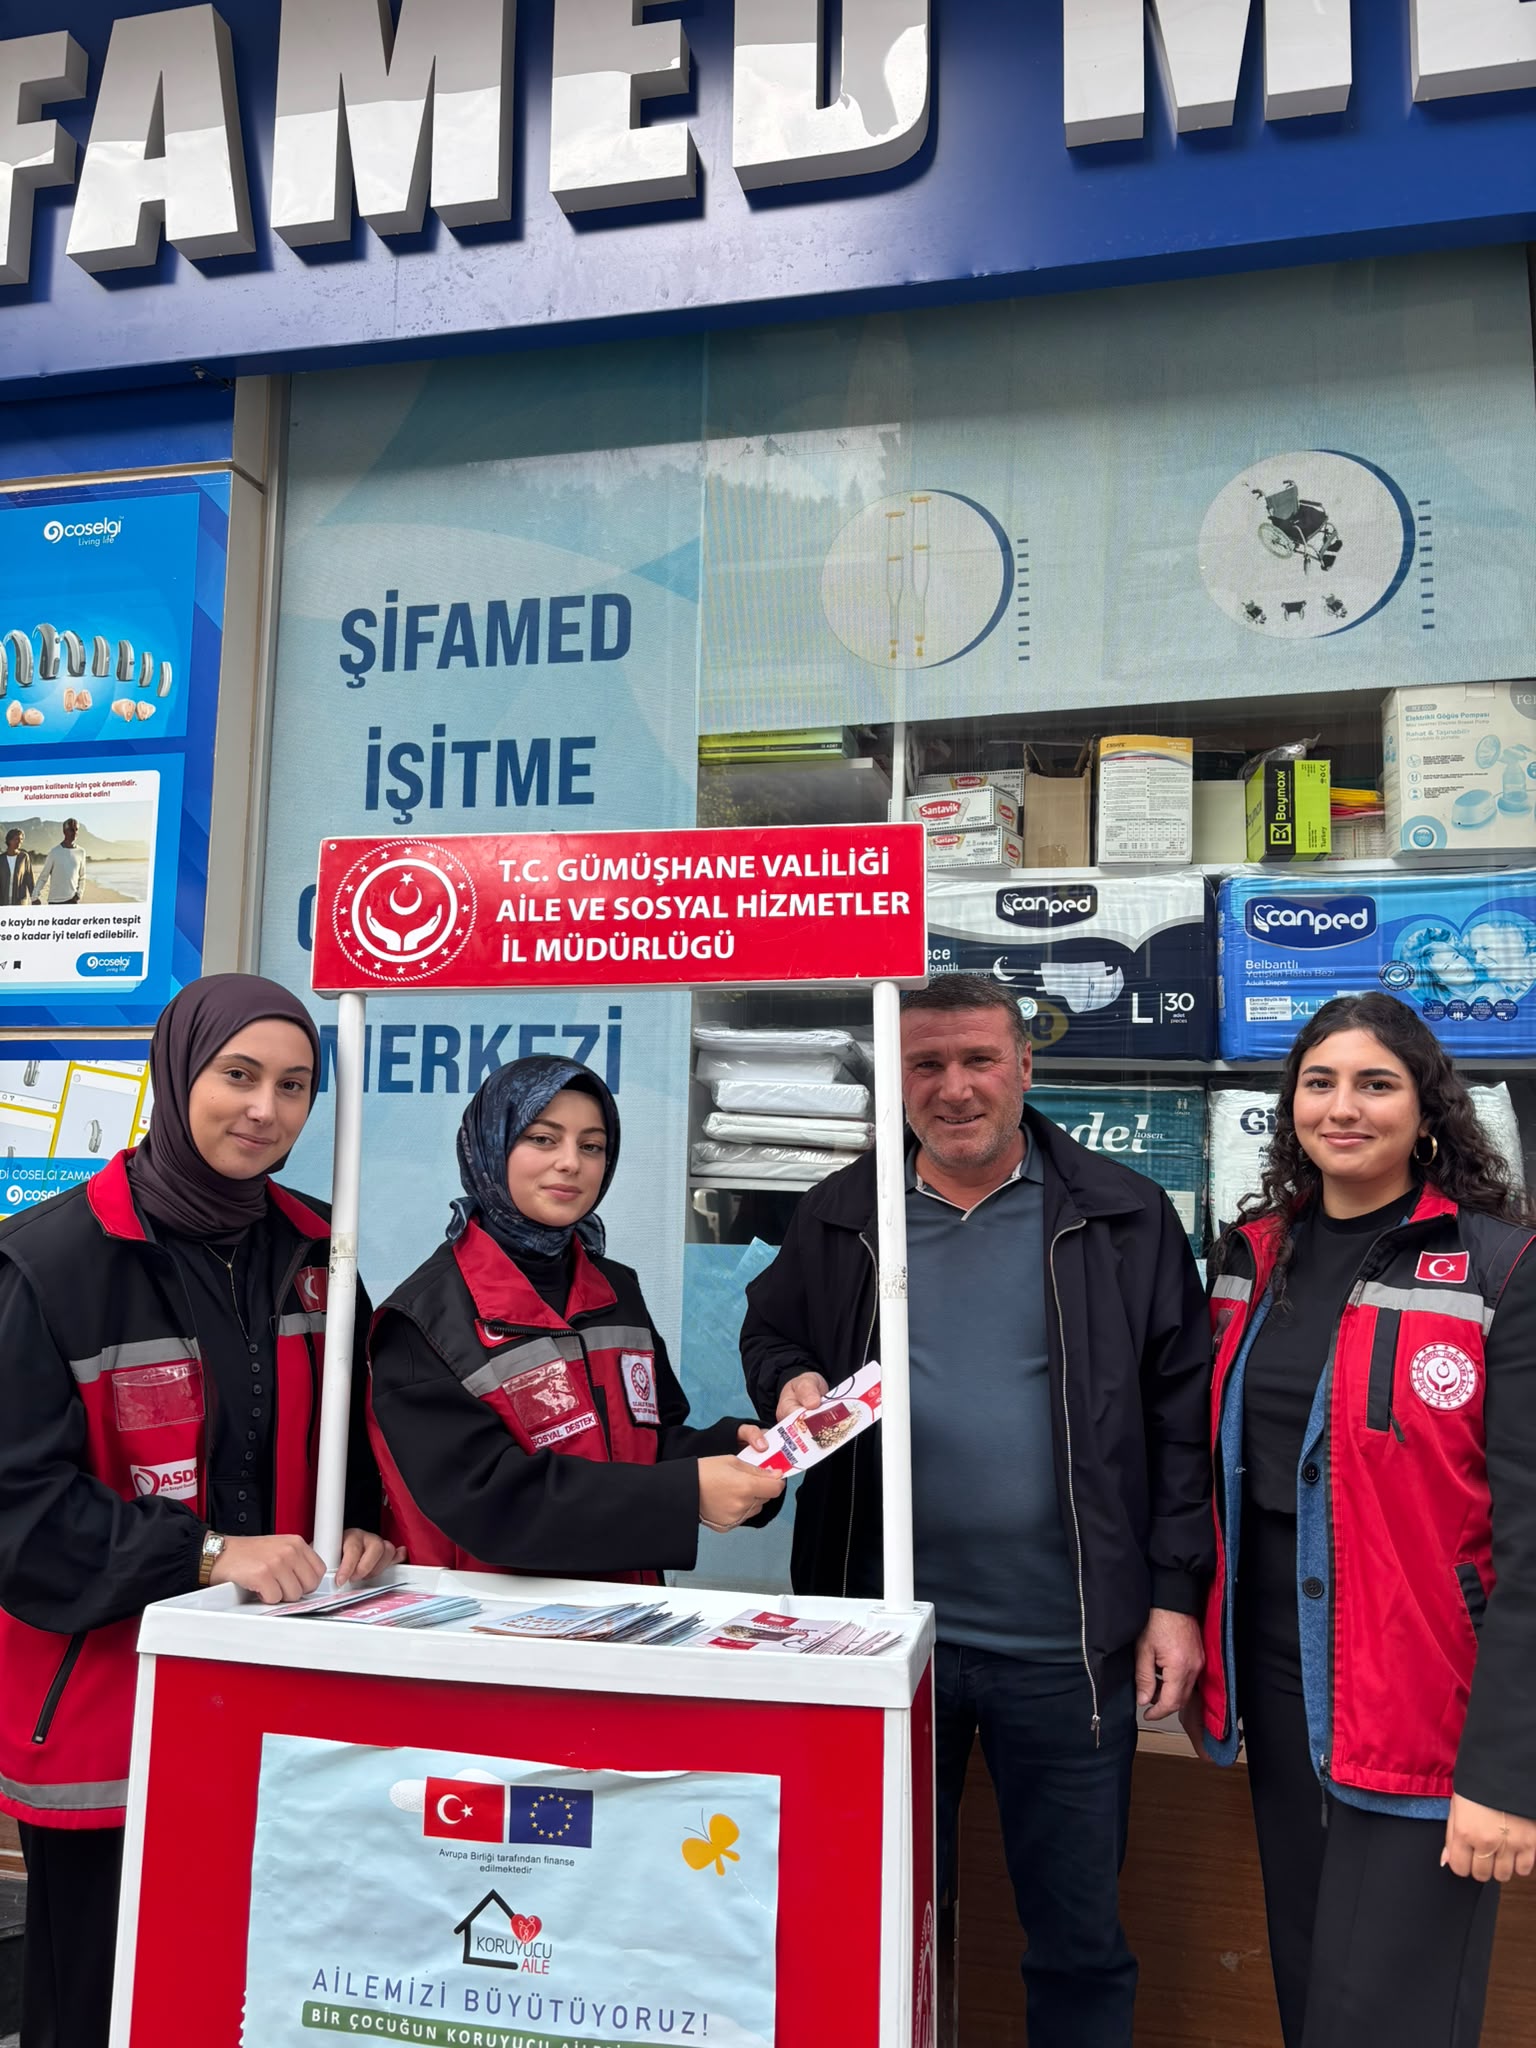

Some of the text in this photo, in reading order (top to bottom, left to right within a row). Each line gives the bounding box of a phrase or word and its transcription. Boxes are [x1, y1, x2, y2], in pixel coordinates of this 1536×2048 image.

[1063, 0, 1536, 147] M
[66, 517, 122, 541] coselgi
[79, 535, 115, 547] Living life
[339, 590, 633, 690] ŞİFAMED
[365, 723, 597, 826] İŞİTME
[0, 784, 20, 794] şitme
[921, 802, 959, 817] Santavik
[498, 846, 891, 887] T.C. GÜMÜŞHANE VALİLİĞİ
[495, 887, 911, 922] AİLE VE SOSYAL HİZMETLER
[1012, 894, 1092, 918] canped
[8, 917, 36, 929] kaybı
[52, 917, 81, 926] kadar
[82, 917, 111, 925] erken
[112, 914, 141, 926] tespit
[1266, 907, 1368, 935] canped
[22, 931, 51, 940] kadar
[52, 930, 65, 942] iyi
[66, 930, 92, 940] telafi
[93, 928, 139, 940] edilebilir.
[502, 929, 735, 963] İL MÜDÜRLÜGÜ
[1245, 960, 1299, 970] Belbantlı
[1132, 992, 1195, 1024] L 30
[1292, 1001, 1315, 1016] XL
[24, 1186, 60, 1202] cosel
[564, 1415, 596, 1436] DESTEK
[439, 1848, 575, 1866] Avrupa Birliği tarafından finanse
[479, 1865, 533, 1875] edilmektedir
[476, 1936, 553, 1959] KORUYUCU
[521, 1956, 551, 1975] AİLE
[312, 1967, 710, 2037] AİLEMİZİ BÜYÜTÜYORUZ!
[311, 2006, 341, 2026] BİR
[349, 2013, 438, 2040] ÇOCUĞUN
